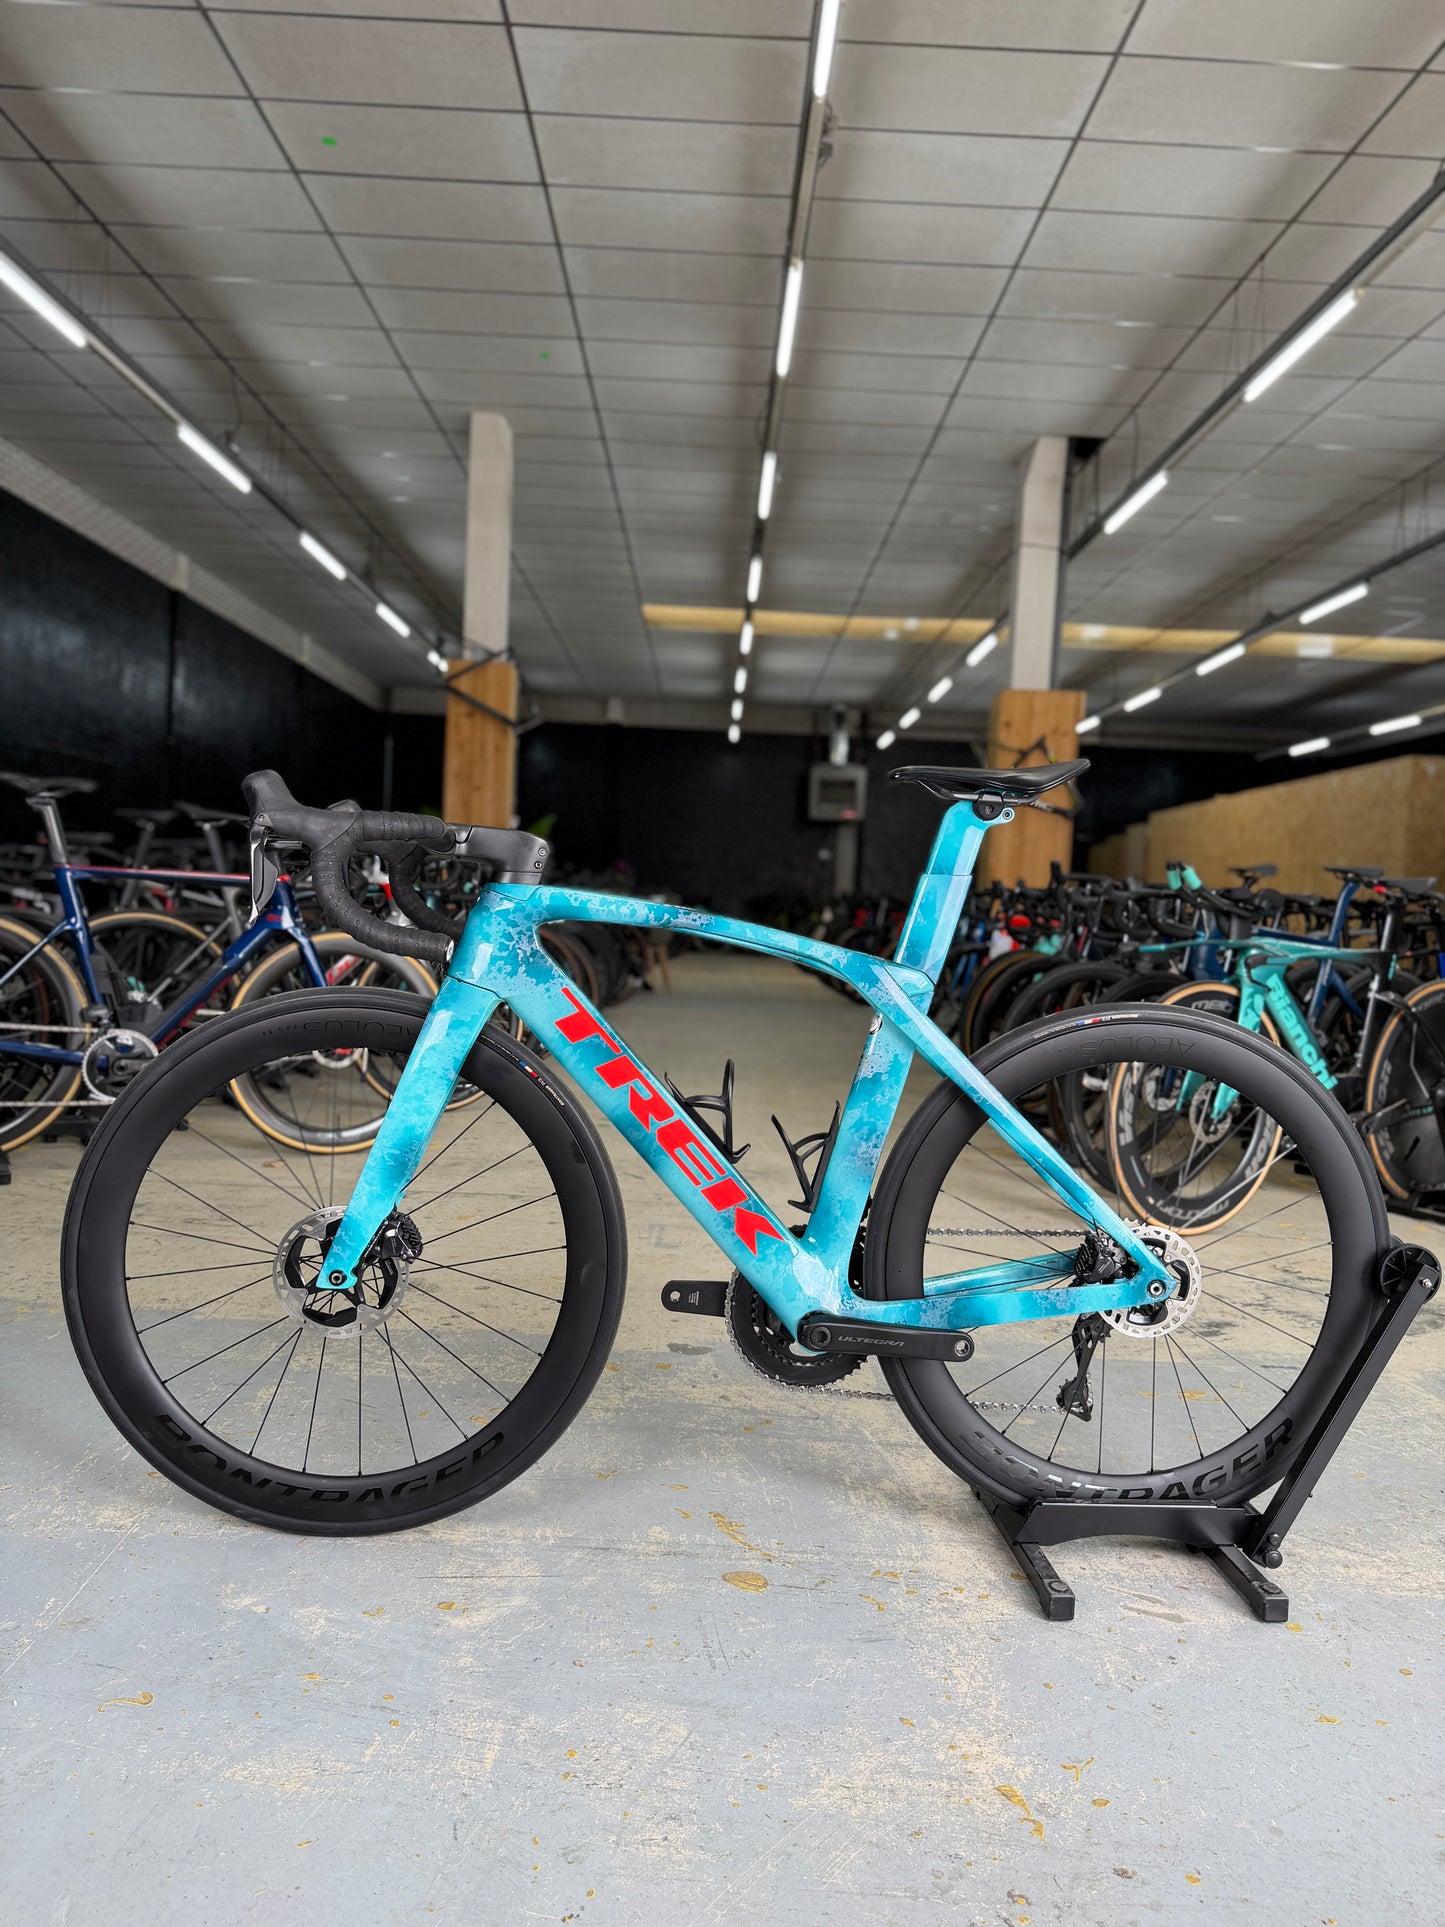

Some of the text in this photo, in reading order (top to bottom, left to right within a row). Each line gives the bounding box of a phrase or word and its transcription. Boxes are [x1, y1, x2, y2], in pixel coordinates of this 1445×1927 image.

[1080, 1034, 1198, 1057] AEOLUS
[1265, 973, 1339, 1091] Bianchi
[554, 986, 785, 1257] TREK
[838, 1334, 905, 1348] ULTEGRA
